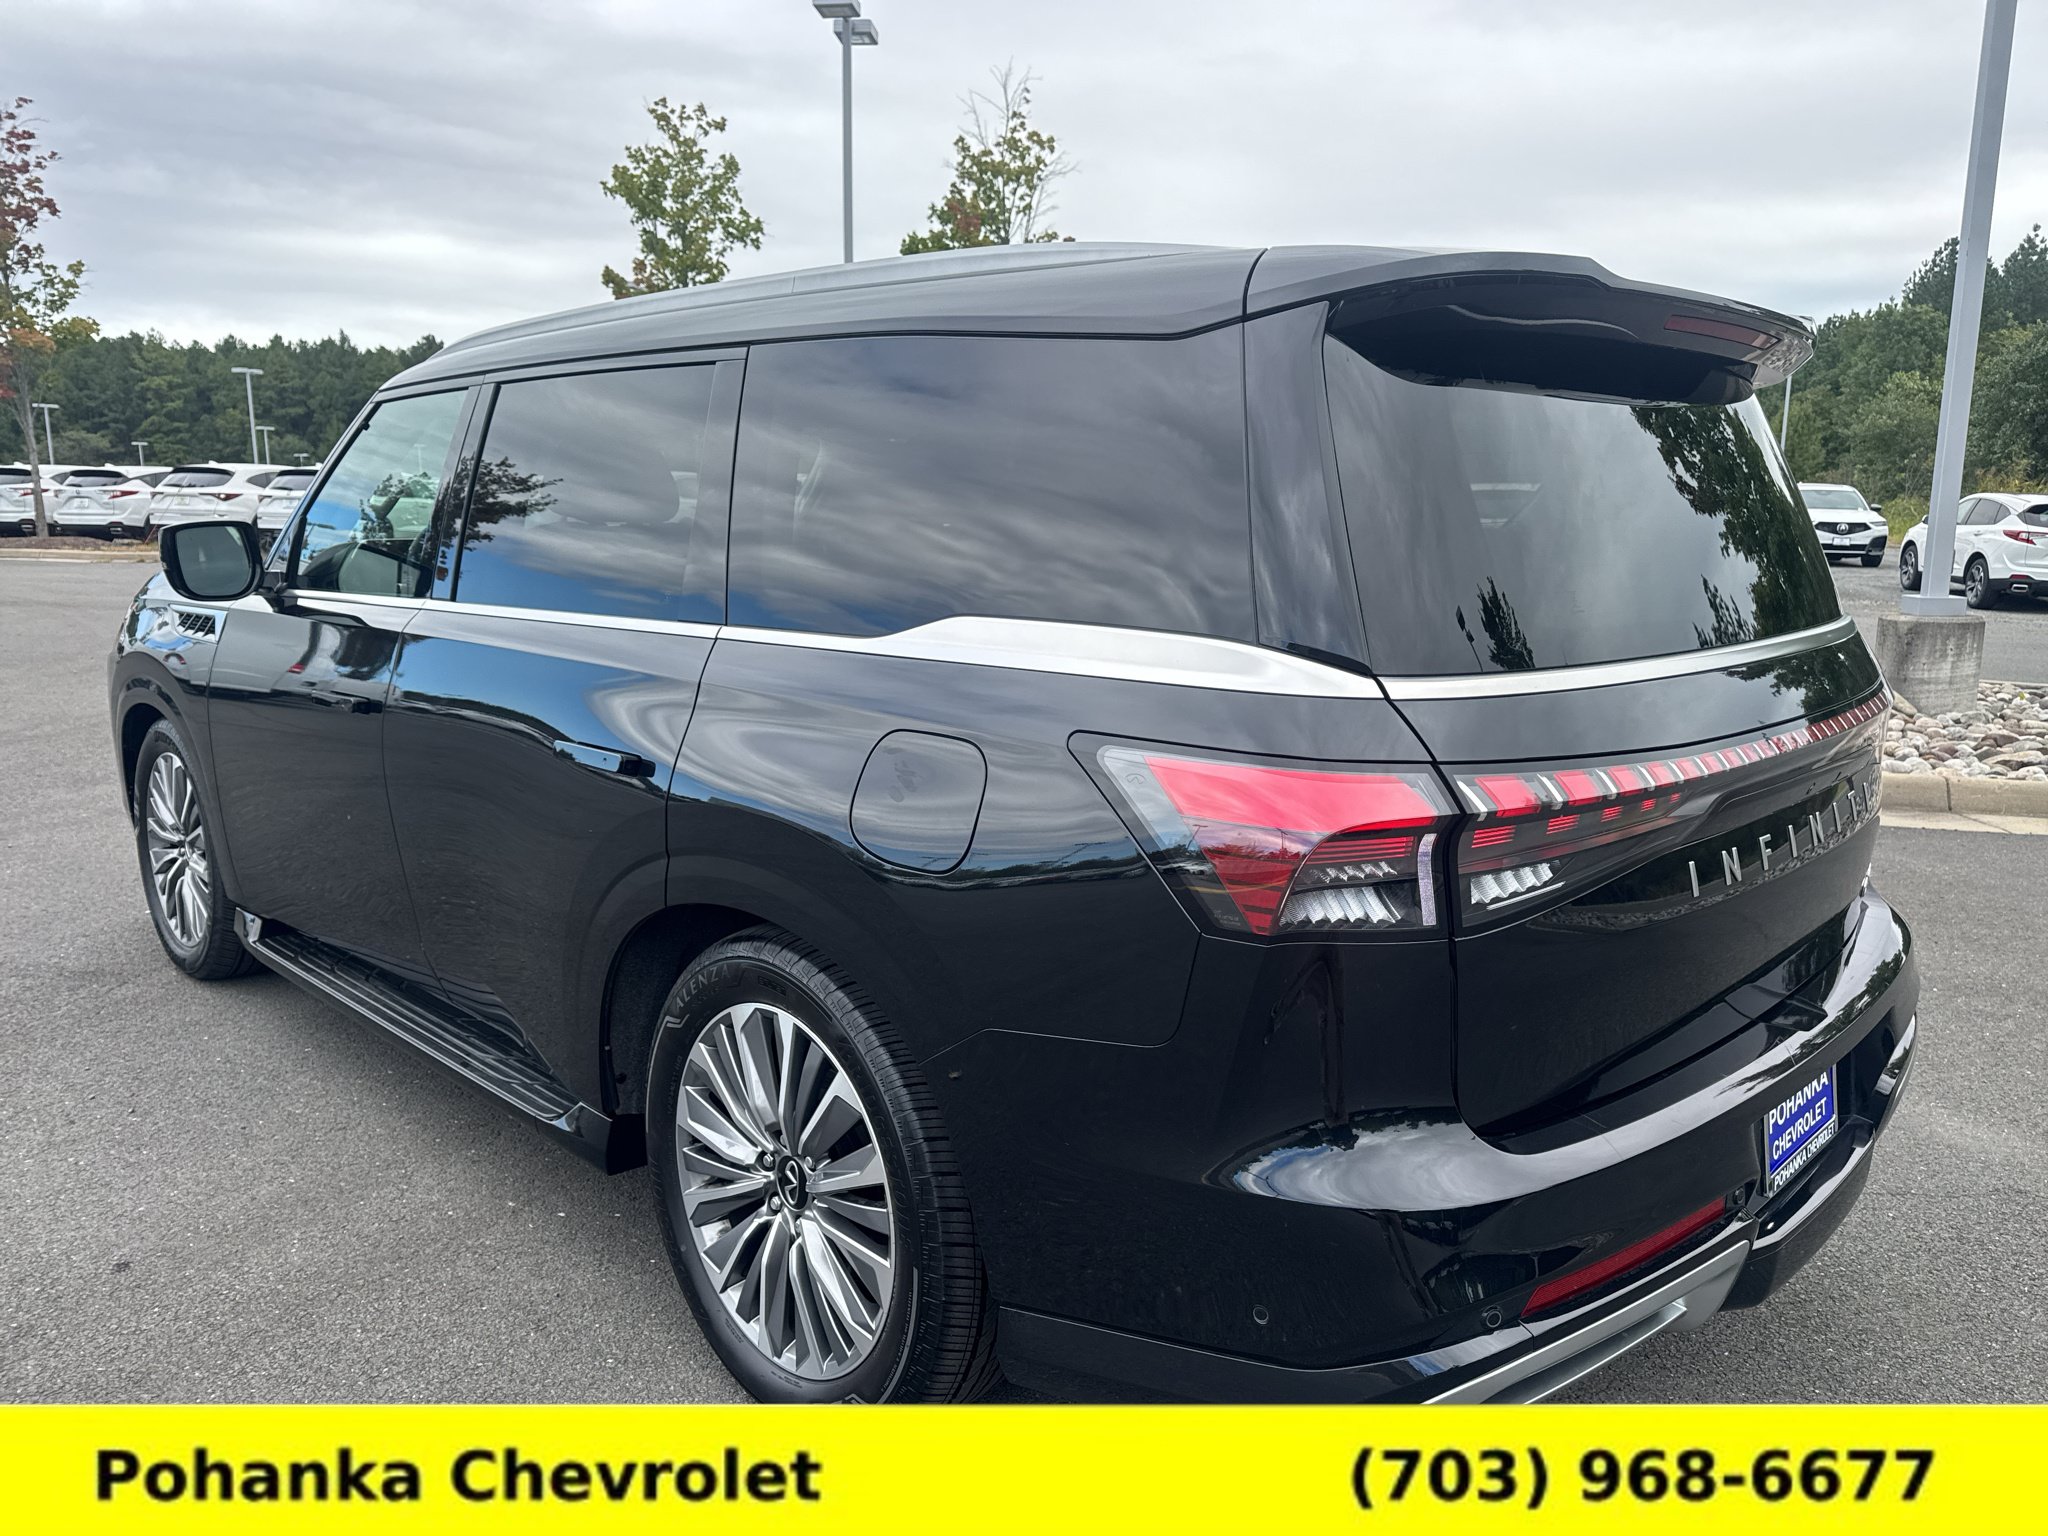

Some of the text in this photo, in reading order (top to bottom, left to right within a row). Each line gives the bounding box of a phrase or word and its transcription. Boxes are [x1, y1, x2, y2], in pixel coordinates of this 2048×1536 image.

[1688, 782, 1870, 898] INFINITI
[674, 963, 731, 1010] ALENZA
[1768, 1071, 1829, 1135] POHANKA
[1772, 1097, 1827, 1160] CHEVROLET
[1773, 1122, 1836, 1191] POHANKA CHEVROLET
